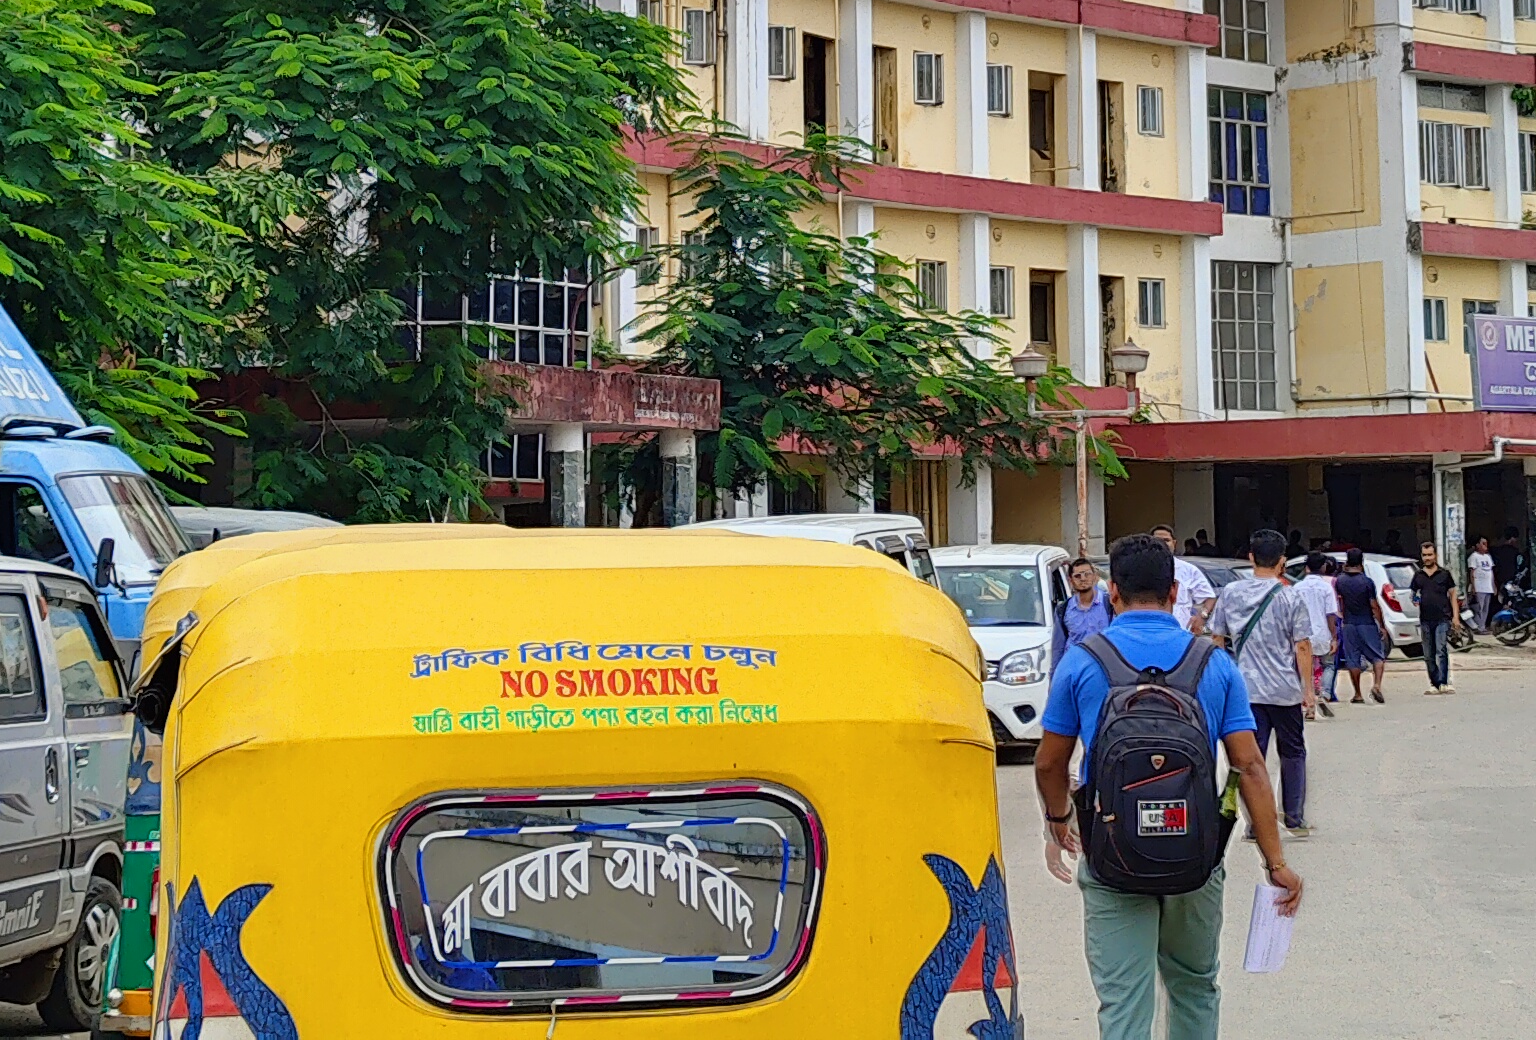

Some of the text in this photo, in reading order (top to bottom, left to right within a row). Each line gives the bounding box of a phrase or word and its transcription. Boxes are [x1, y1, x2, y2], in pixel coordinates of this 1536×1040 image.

[410, 641, 778, 678] ট্রাফিক বিধি মেনে চলুন
[500, 667, 719, 698] NO SMOKING
[412, 707, 453, 733] যাত্রি
[458, 705, 501, 731] বাহী
[581, 707, 619, 727] পণ্য
[625, 706, 669, 726] বহন
[675, 705, 714, 725] করা
[719, 698, 778, 724] নিষেধ
[1148, 813, 1178, 824] USA
[442, 834, 754, 954] মা বাবার আশীর্বাদ
